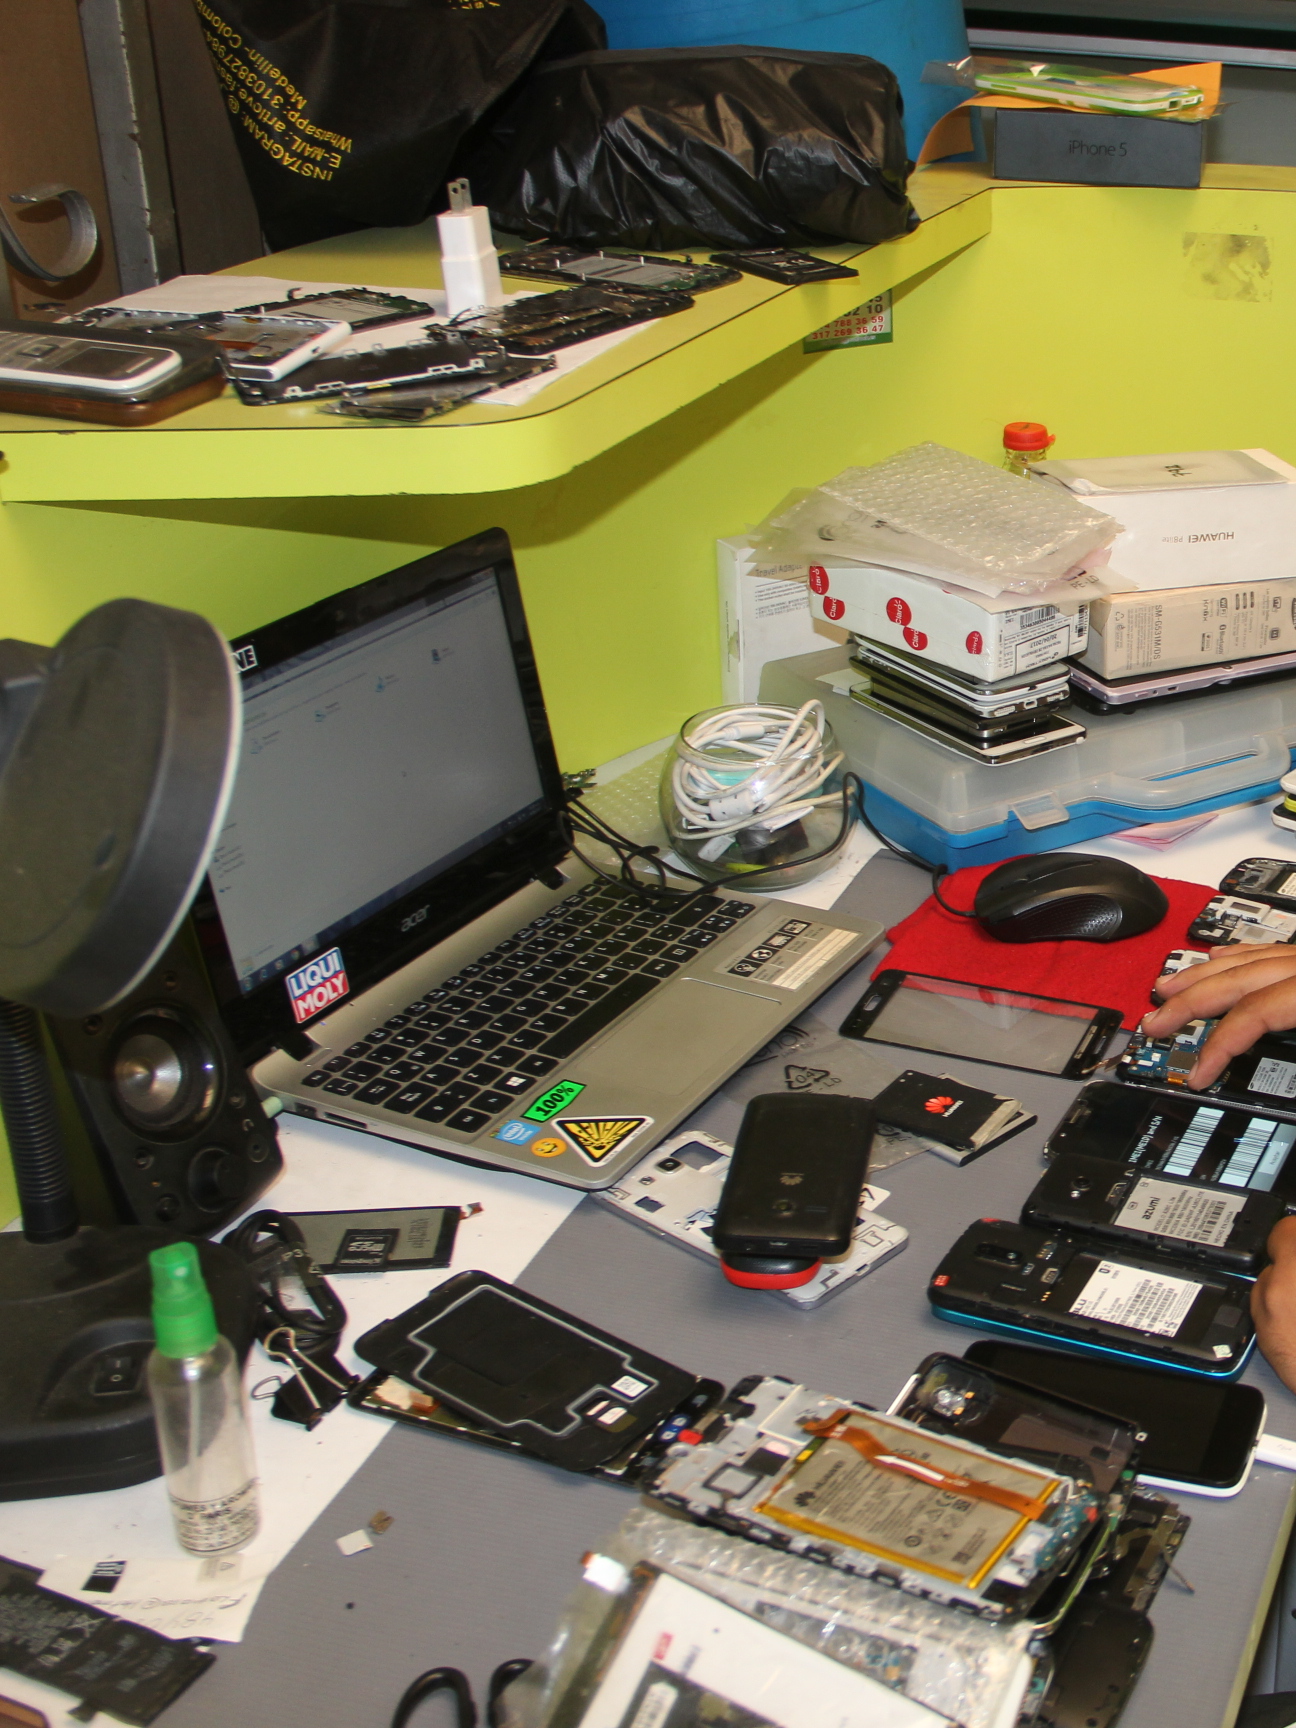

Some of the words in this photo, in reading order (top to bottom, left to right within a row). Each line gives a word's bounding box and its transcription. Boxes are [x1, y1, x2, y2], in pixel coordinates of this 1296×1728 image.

[283, 105, 352, 153] Whatsapp:
[242, 111, 333, 181] INSTAGRAM:
[285, 131, 342, 169] E-MAIL:
[1068, 140, 1116, 157] iPhone
[1119, 142, 1128, 157] 5
[855, 318, 868, 326] 36
[871, 315, 884, 324] 59
[867, 304, 883, 314] 10
[856, 326, 868, 335] 36
[872, 325, 884, 333] 47
[1188, 531, 1235, 544] HUAWEI
[1153, 604, 1163, 660] SM-G531M/DS
[401, 905, 430, 932] acer
[289, 951, 341, 998] LIQUI
[296, 972, 346, 1019] MOLY
[535, 1084, 575, 1117] 100%
[1128, 1132, 1153, 1163] IMEI(MEID)
[1151, 1115, 1163, 1130] S/N
[1141, 1196, 1160, 1220] azumi
